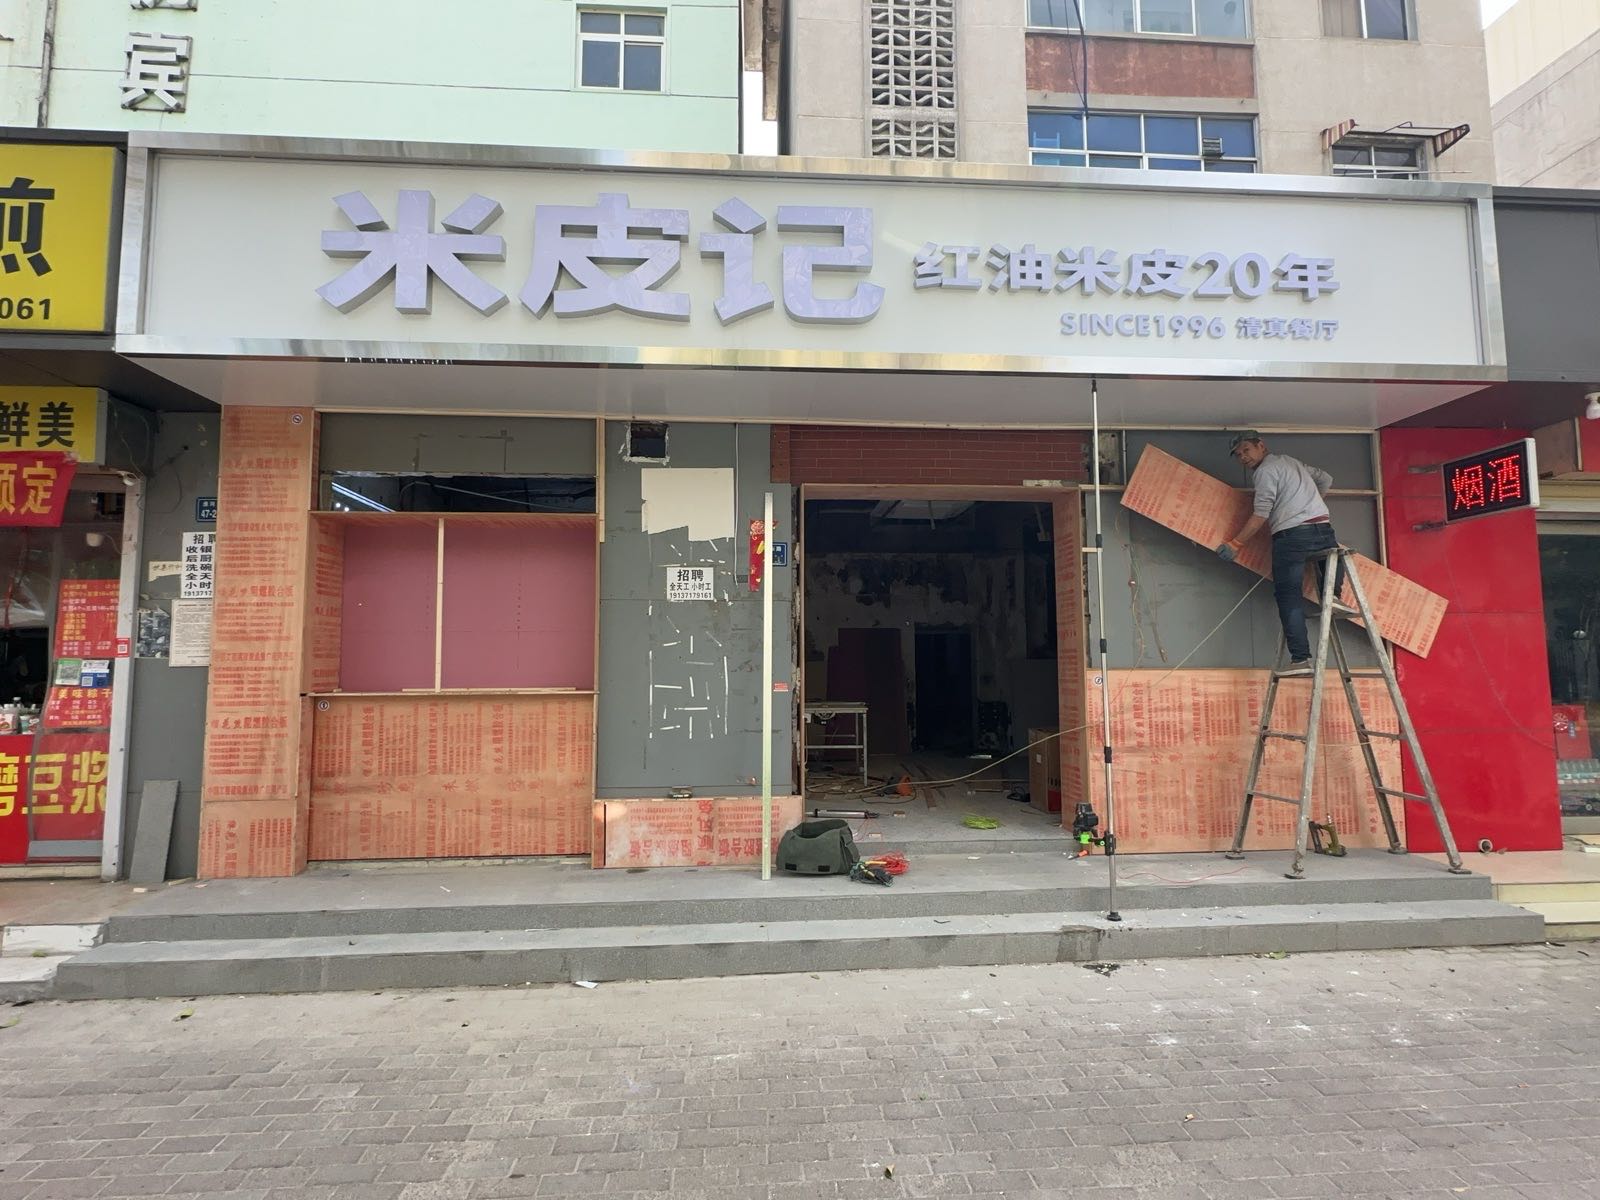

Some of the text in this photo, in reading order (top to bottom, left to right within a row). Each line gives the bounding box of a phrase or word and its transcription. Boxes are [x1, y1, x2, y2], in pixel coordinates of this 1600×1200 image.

[315, 191, 886, 326] 米皮记
[913, 244, 1340, 302] 红油米皮20年
[0, 297, 51, 320] 061
[1060, 312, 1338, 340] SINCE1996 清真餐厅
[0, 401, 75, 447] 鲜美
[1452, 454, 1521, 510] 烟酒
[185, 572, 212, 580] 全天
[185, 581, 212, 589] 小时
[669, 582, 712, 591] 全天工 小时工
[677, 569, 704, 581] 招聘
